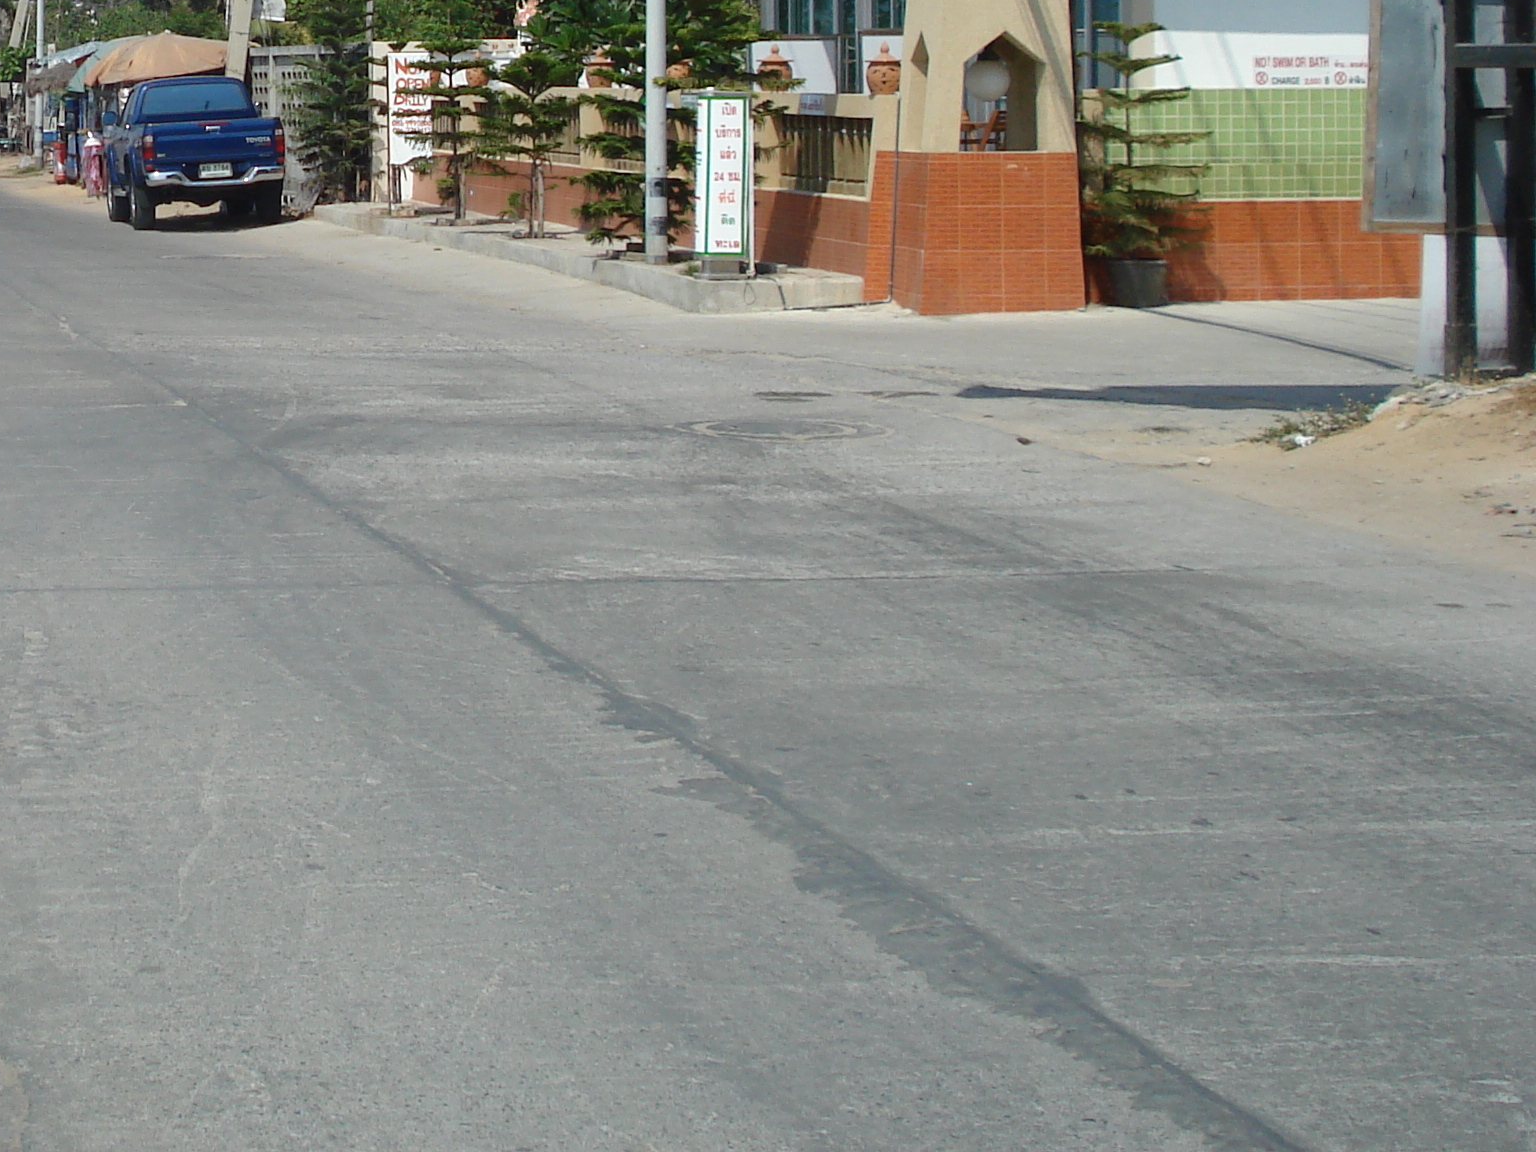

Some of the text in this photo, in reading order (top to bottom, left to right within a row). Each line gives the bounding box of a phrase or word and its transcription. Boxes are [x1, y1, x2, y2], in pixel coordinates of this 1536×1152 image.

[1272, 57, 1294, 68] SWIM
[1309, 56, 1330, 68] BATH
[1271, 76, 1301, 85] CHARGE
[715, 124, 741, 139] บริการ
[245, 136, 271, 144] TOYOTA
